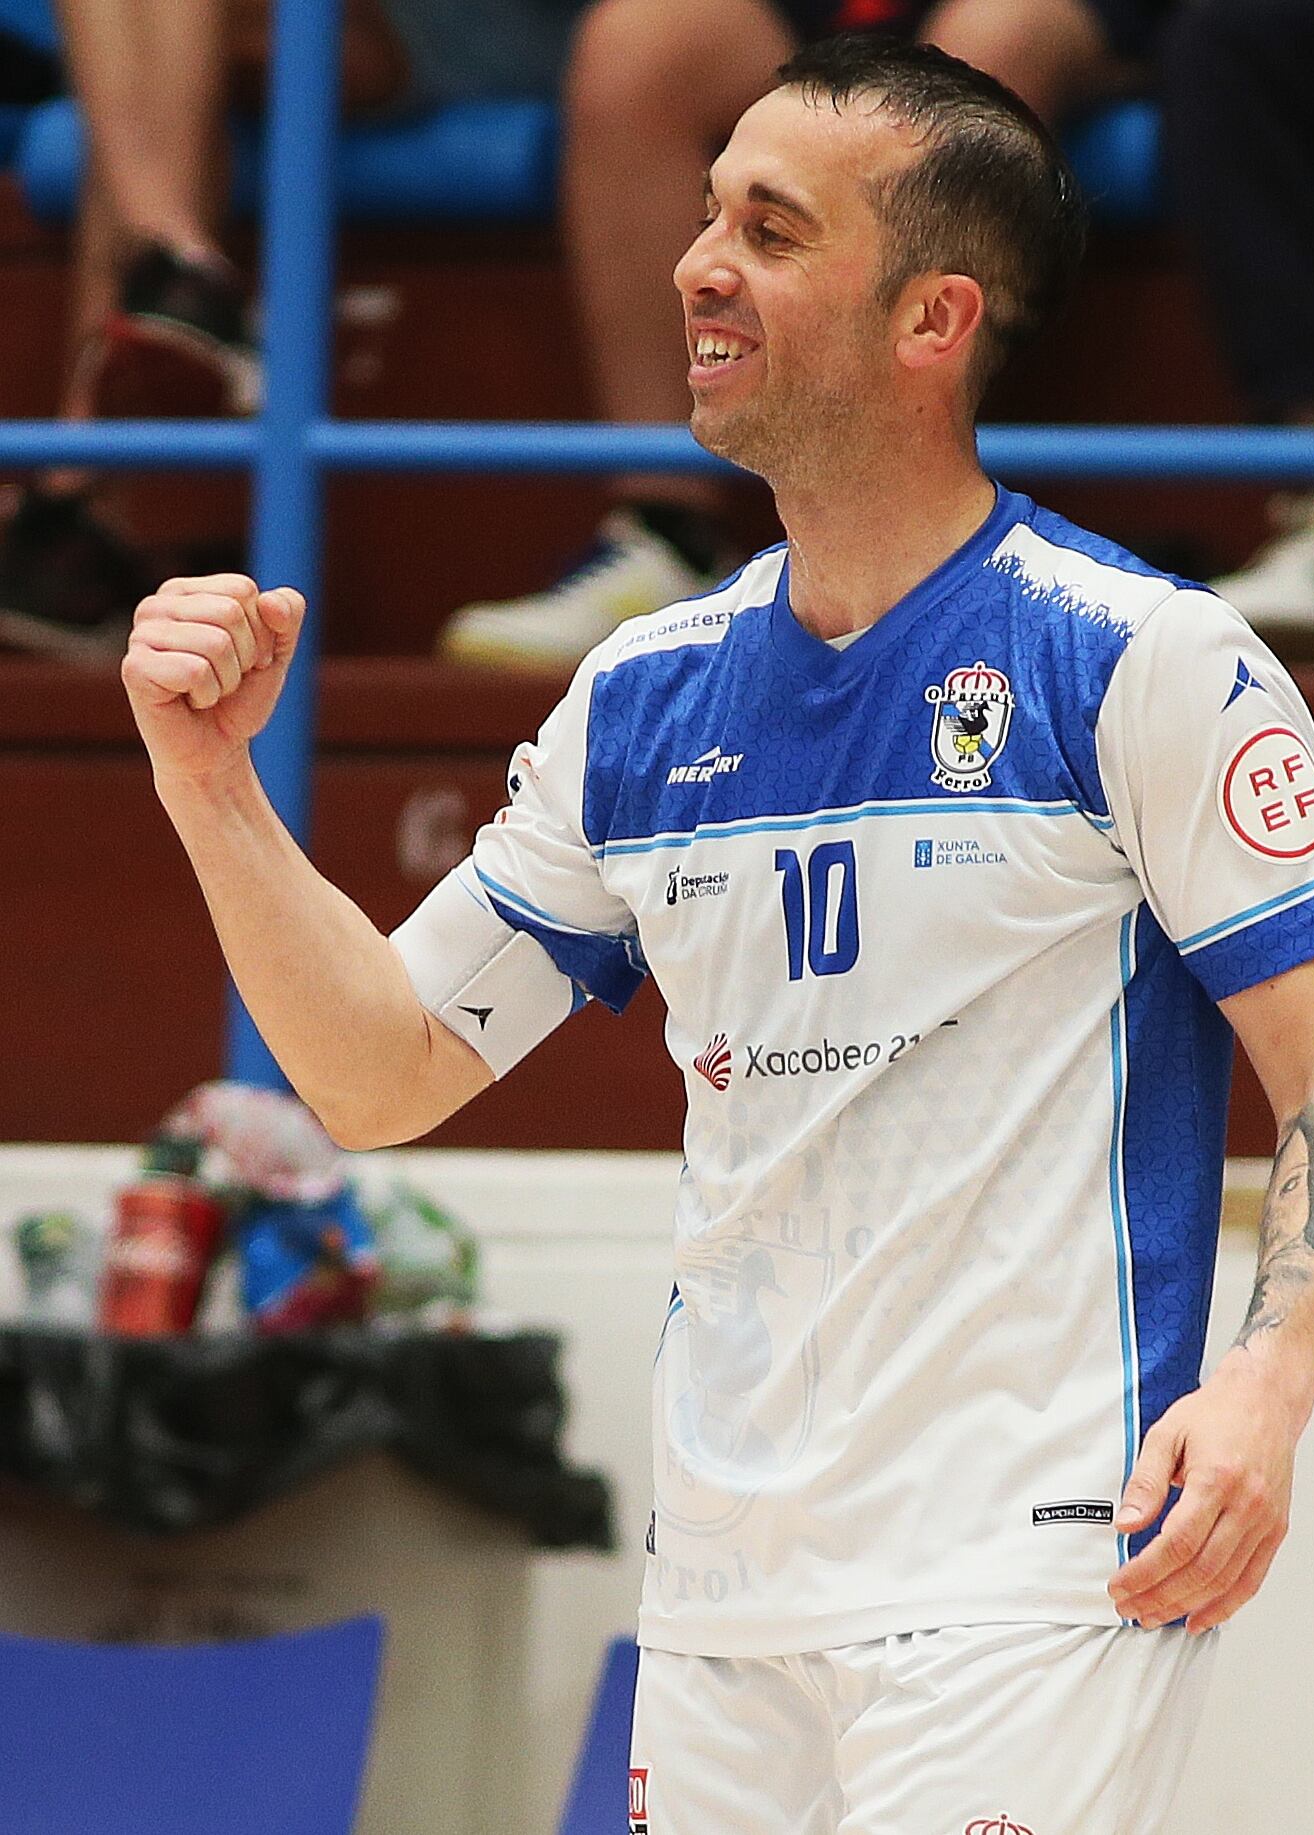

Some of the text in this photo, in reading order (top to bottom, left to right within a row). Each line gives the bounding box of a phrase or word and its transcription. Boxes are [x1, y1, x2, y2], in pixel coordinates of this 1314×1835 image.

[947, 689, 1015, 706] Parrul
[934, 768, 989, 789] Ferrol
[937, 840, 980, 852] XUNTA
[936, 853, 1008, 865] DE GALICIA
[682, 888, 697, 900] DA
[774, 840, 861, 981] 10
[745, 1037, 881, 1078] Xacobeo
